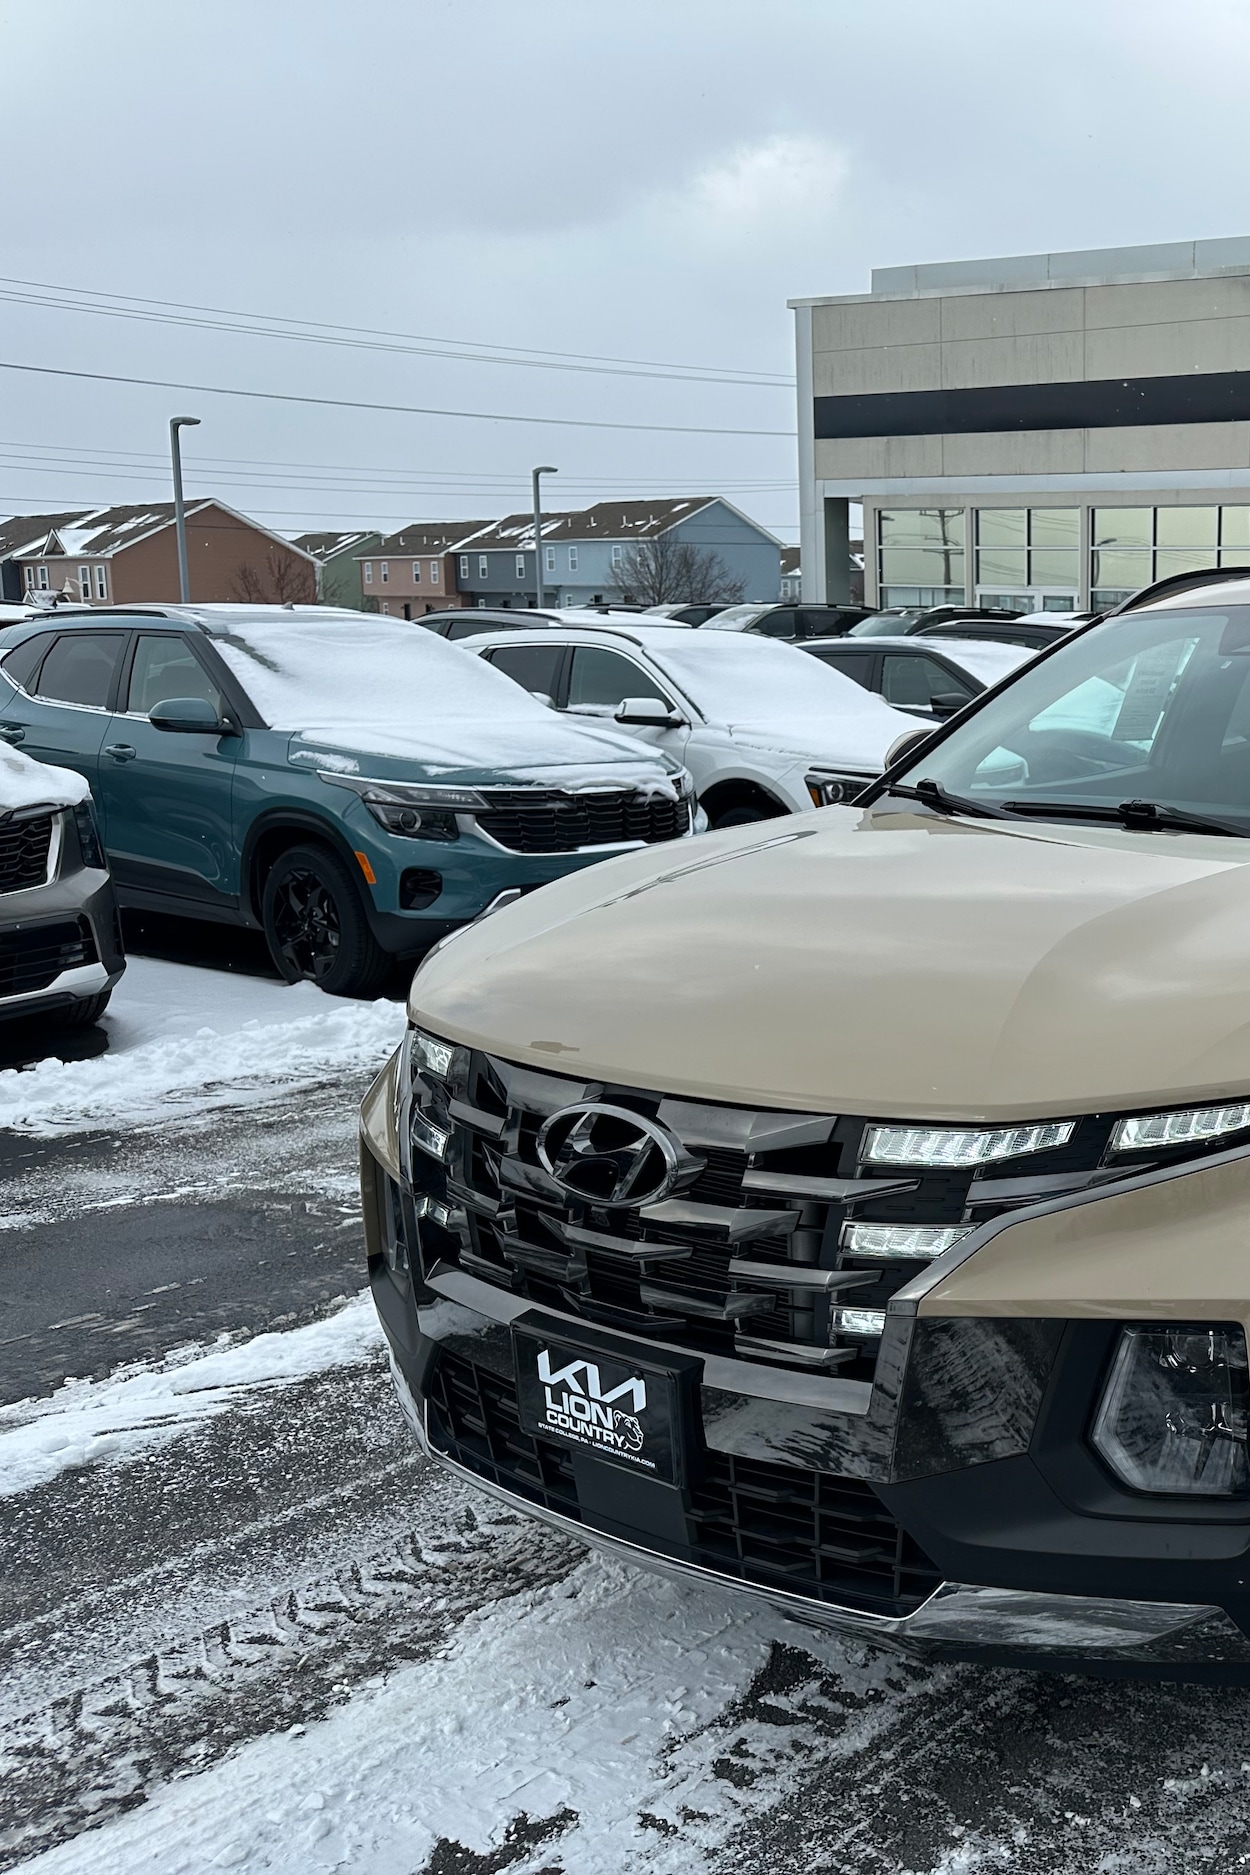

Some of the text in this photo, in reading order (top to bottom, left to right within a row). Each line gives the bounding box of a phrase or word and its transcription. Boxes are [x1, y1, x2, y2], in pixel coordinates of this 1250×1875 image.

[545, 1386, 614, 1431] LION
[546, 1410, 625, 1449] COUNTRY
[537, 1421, 555, 1433] STATE
[592, 1441, 656, 1468] LIONCOUNTRYKIA.COM
